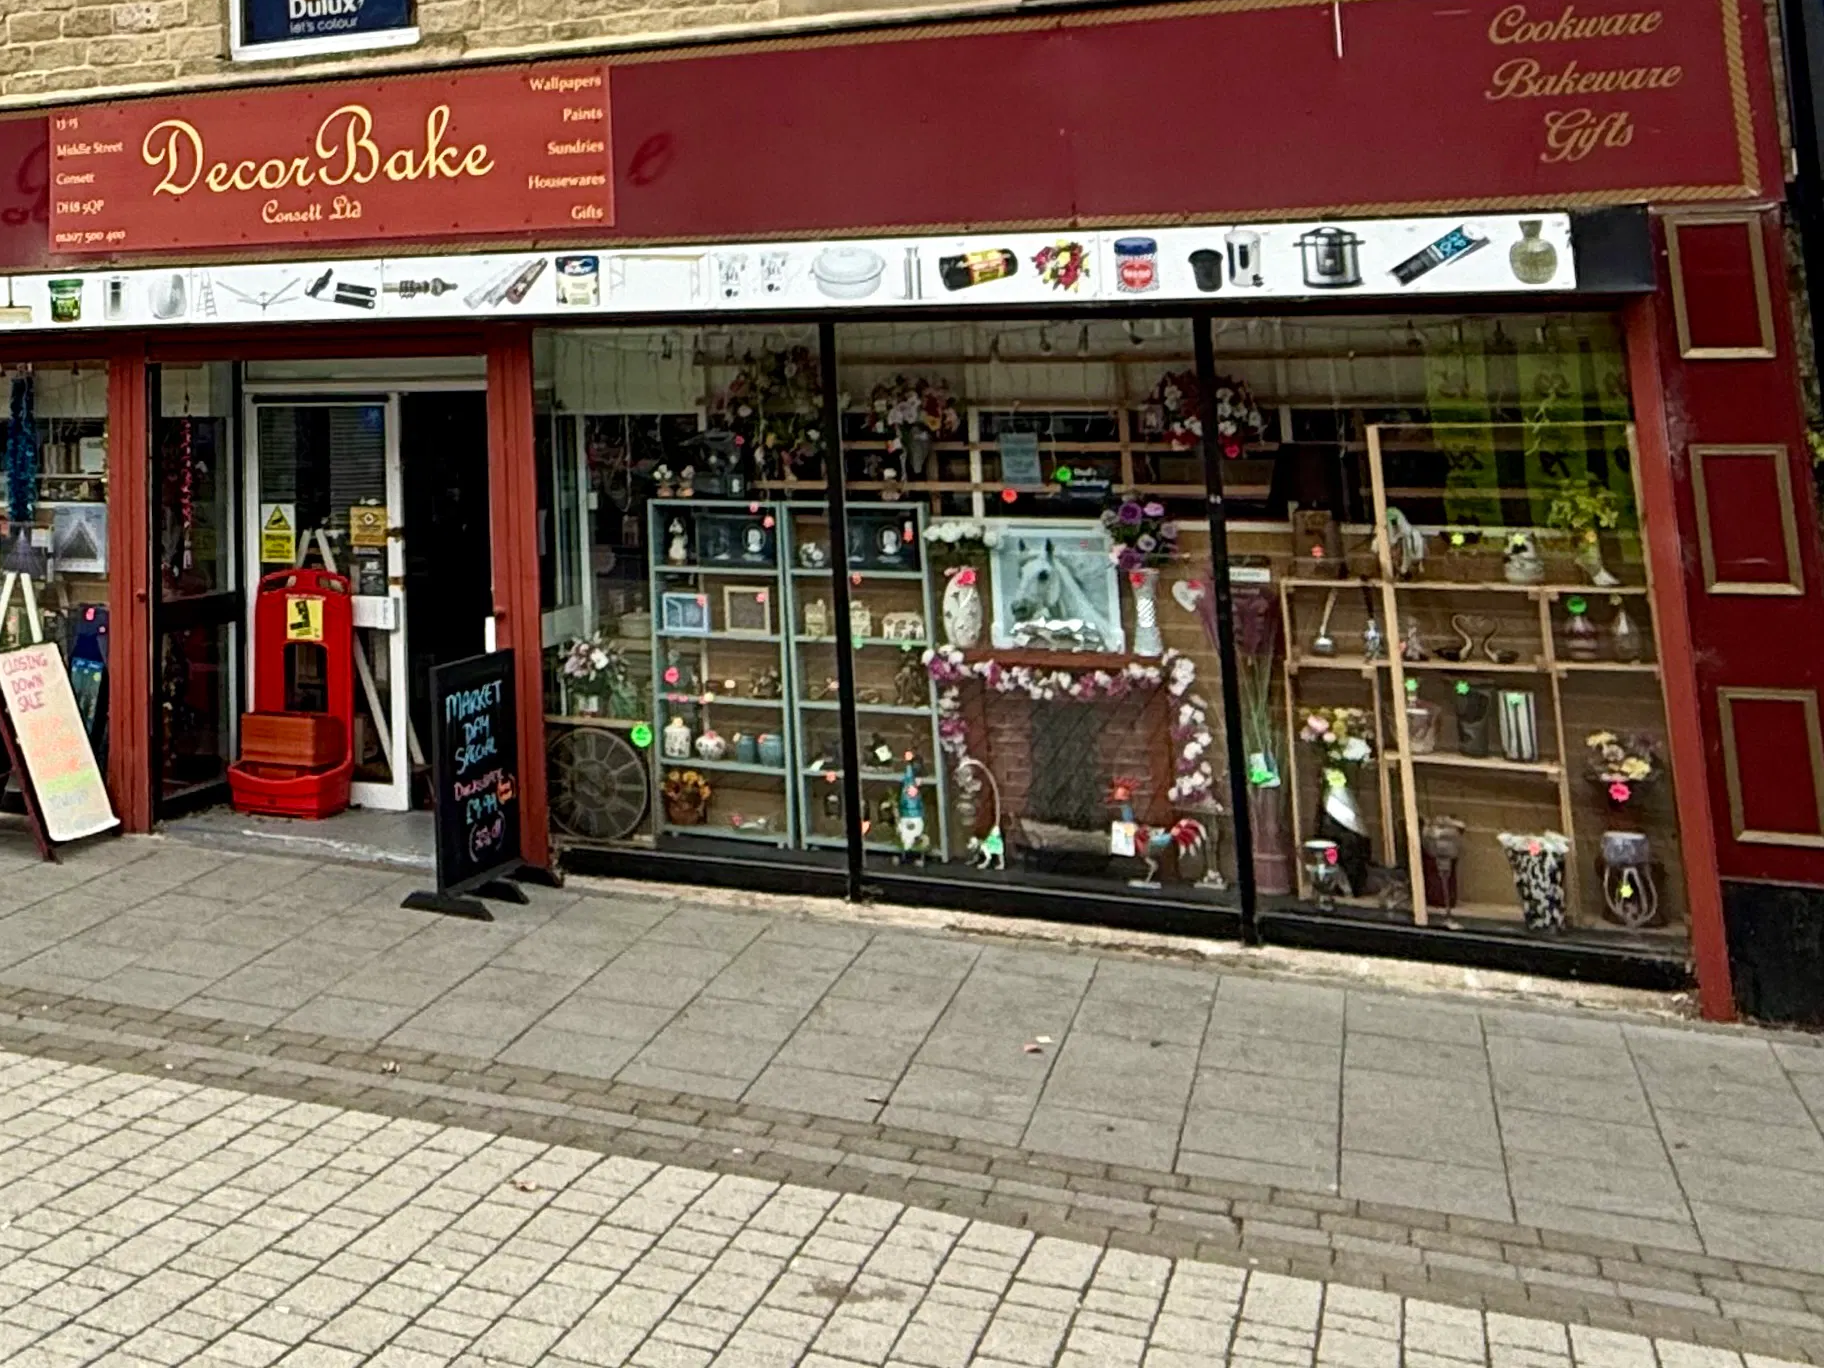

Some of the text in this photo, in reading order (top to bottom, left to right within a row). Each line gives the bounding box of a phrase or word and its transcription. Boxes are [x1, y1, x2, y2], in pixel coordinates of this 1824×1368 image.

[290, 17, 358, 33] let's colour
[1488, 4, 1663, 45] Cookware
[529, 75, 601, 93] Wallpapers
[1485, 58, 1683, 100] Bakeware
[563, 107, 603, 122] Paints
[1540, 108, 1634, 163] Gifts
[93, 141, 123, 154] Street
[547, 137, 604, 155] Sundries
[56, 173, 95, 185] Consett
[528, 174, 606, 189] Housewares
[262, 195, 363, 224] Consett Ltd
[571, 203, 603, 220] Gifts
[85, 231, 104, 244] 500
[2, 652, 49, 676] CLOSING
[11, 673, 45, 695] DOWN
[445, 679, 502, 724] MARKET
[462, 714, 490, 745] DAY
